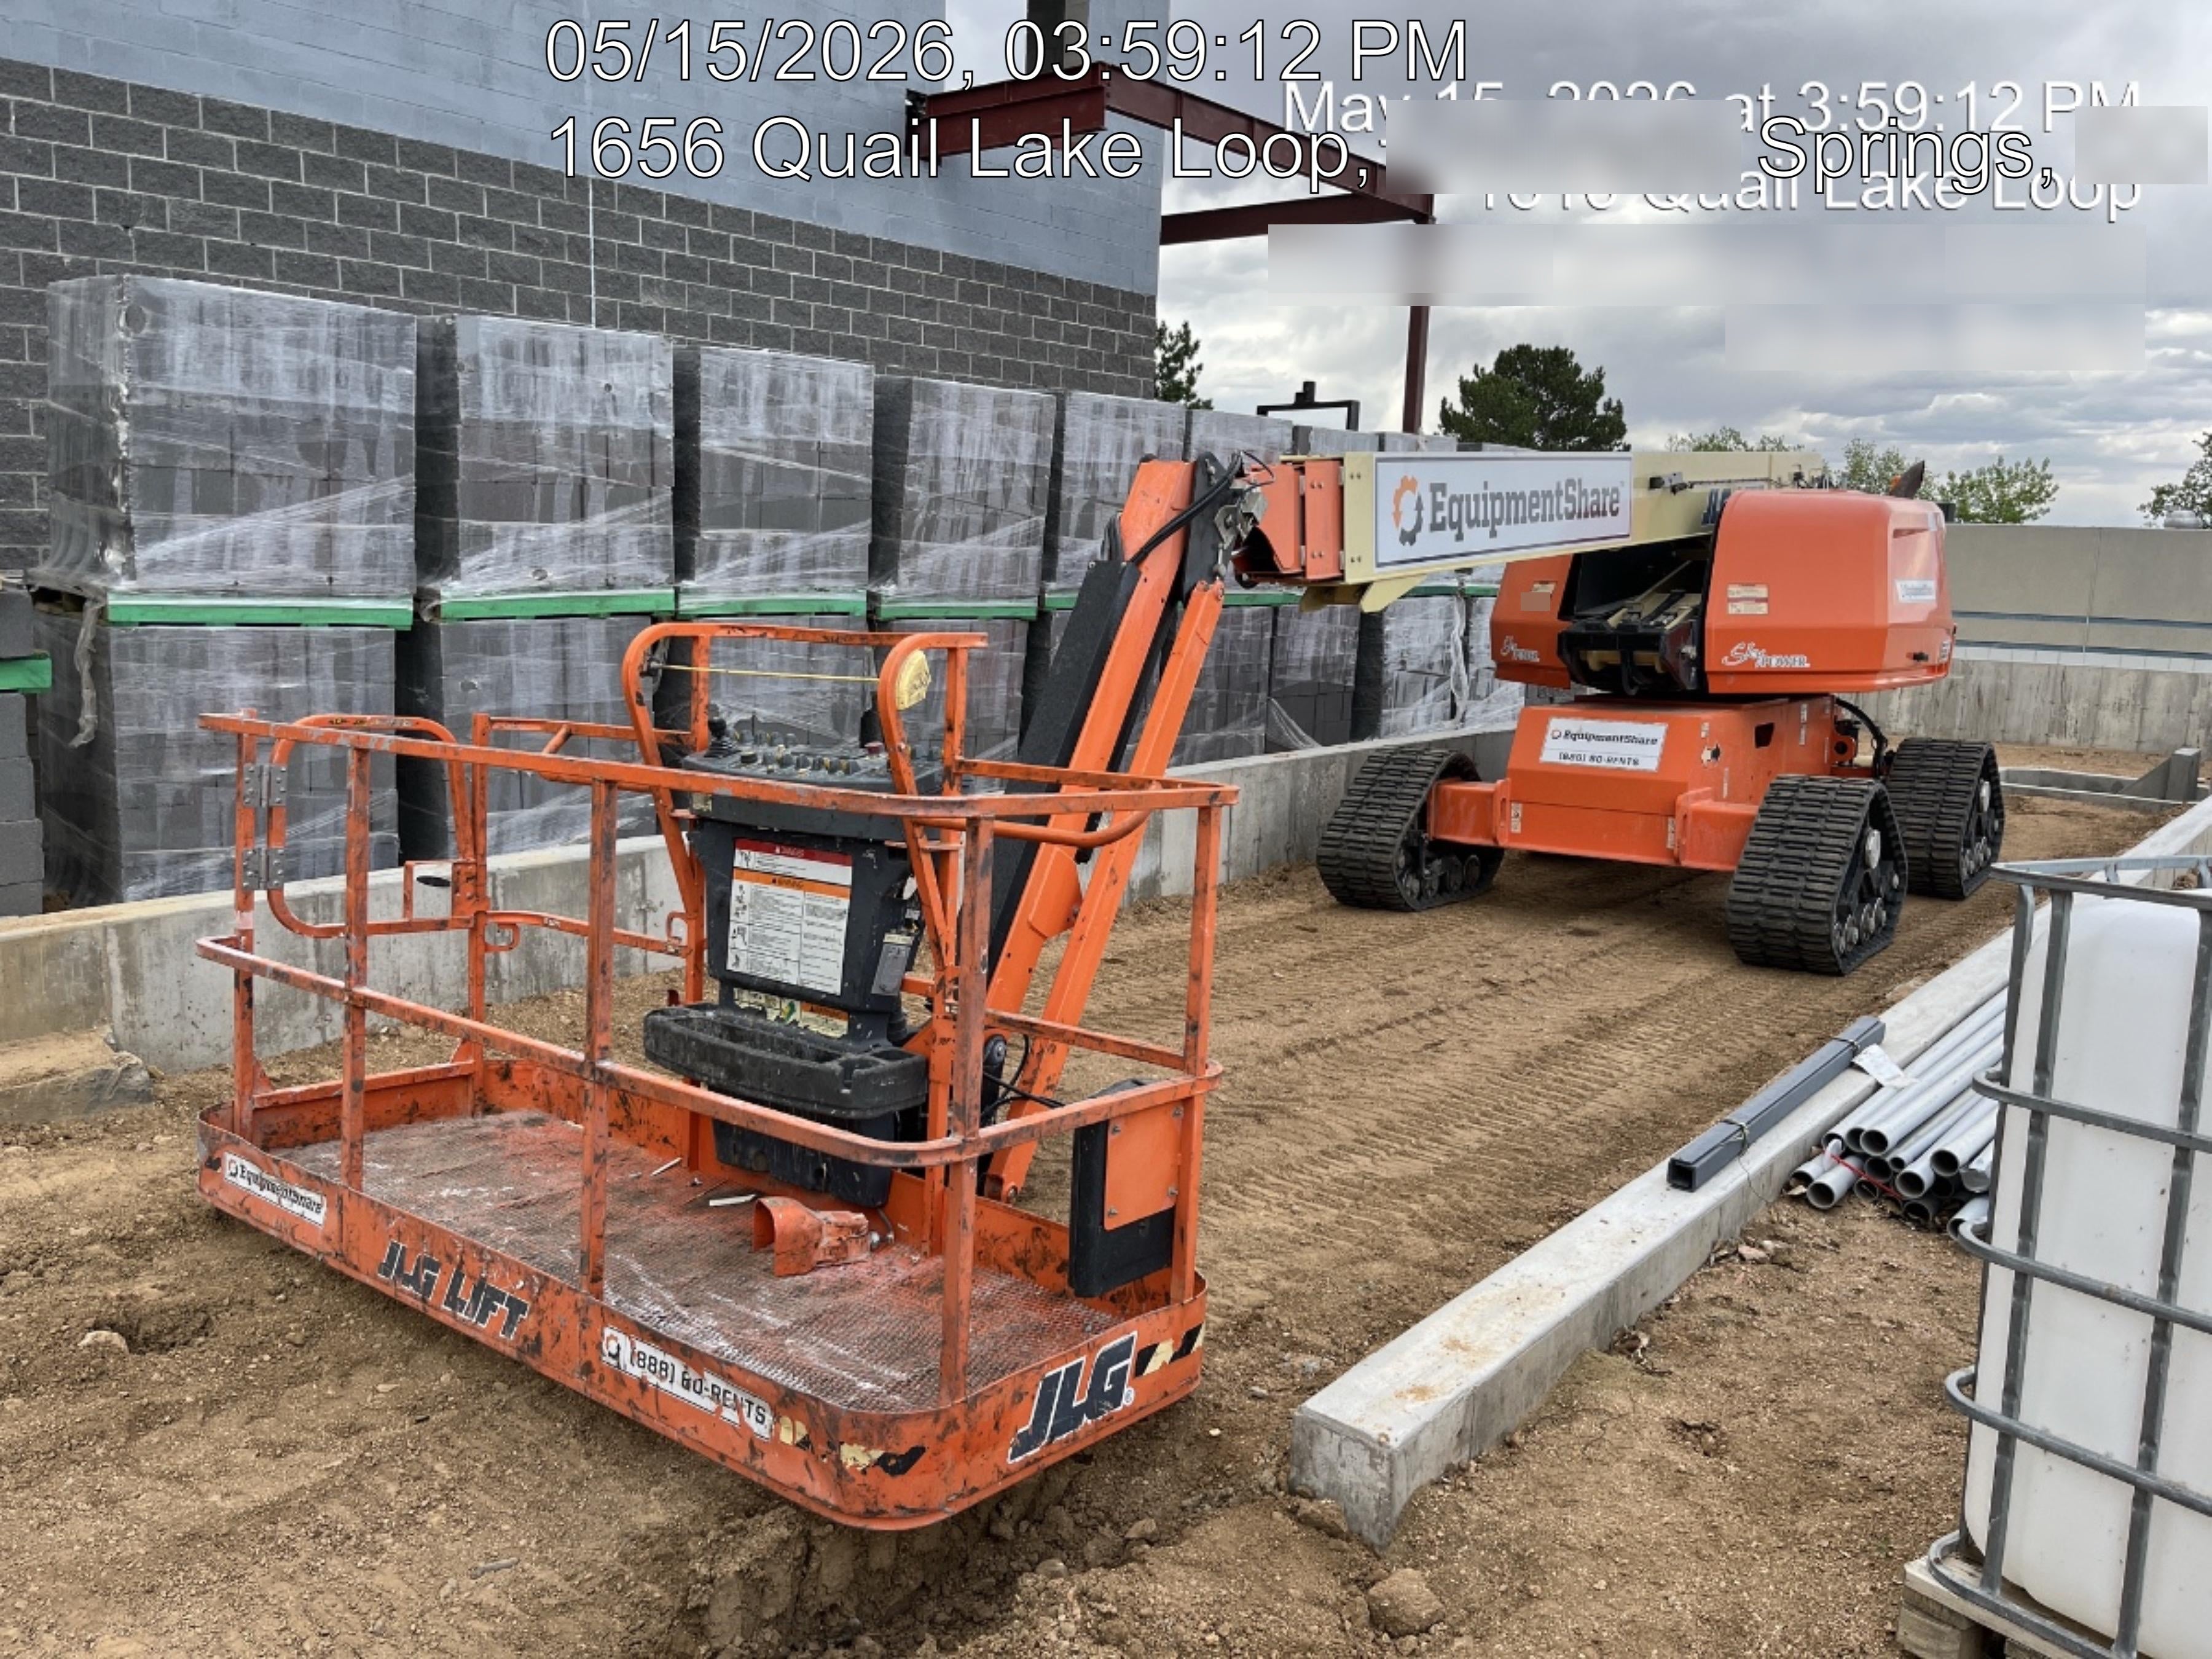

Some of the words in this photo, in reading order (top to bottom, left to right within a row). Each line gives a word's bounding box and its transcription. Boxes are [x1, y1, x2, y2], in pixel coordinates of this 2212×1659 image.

[1429, 477, 1620, 542] EquipmentShare
[377, 1239, 442, 1301] JLG
[442, 1265, 530, 1341] LIFT
[1008, 1330, 1138, 1464] JLG
